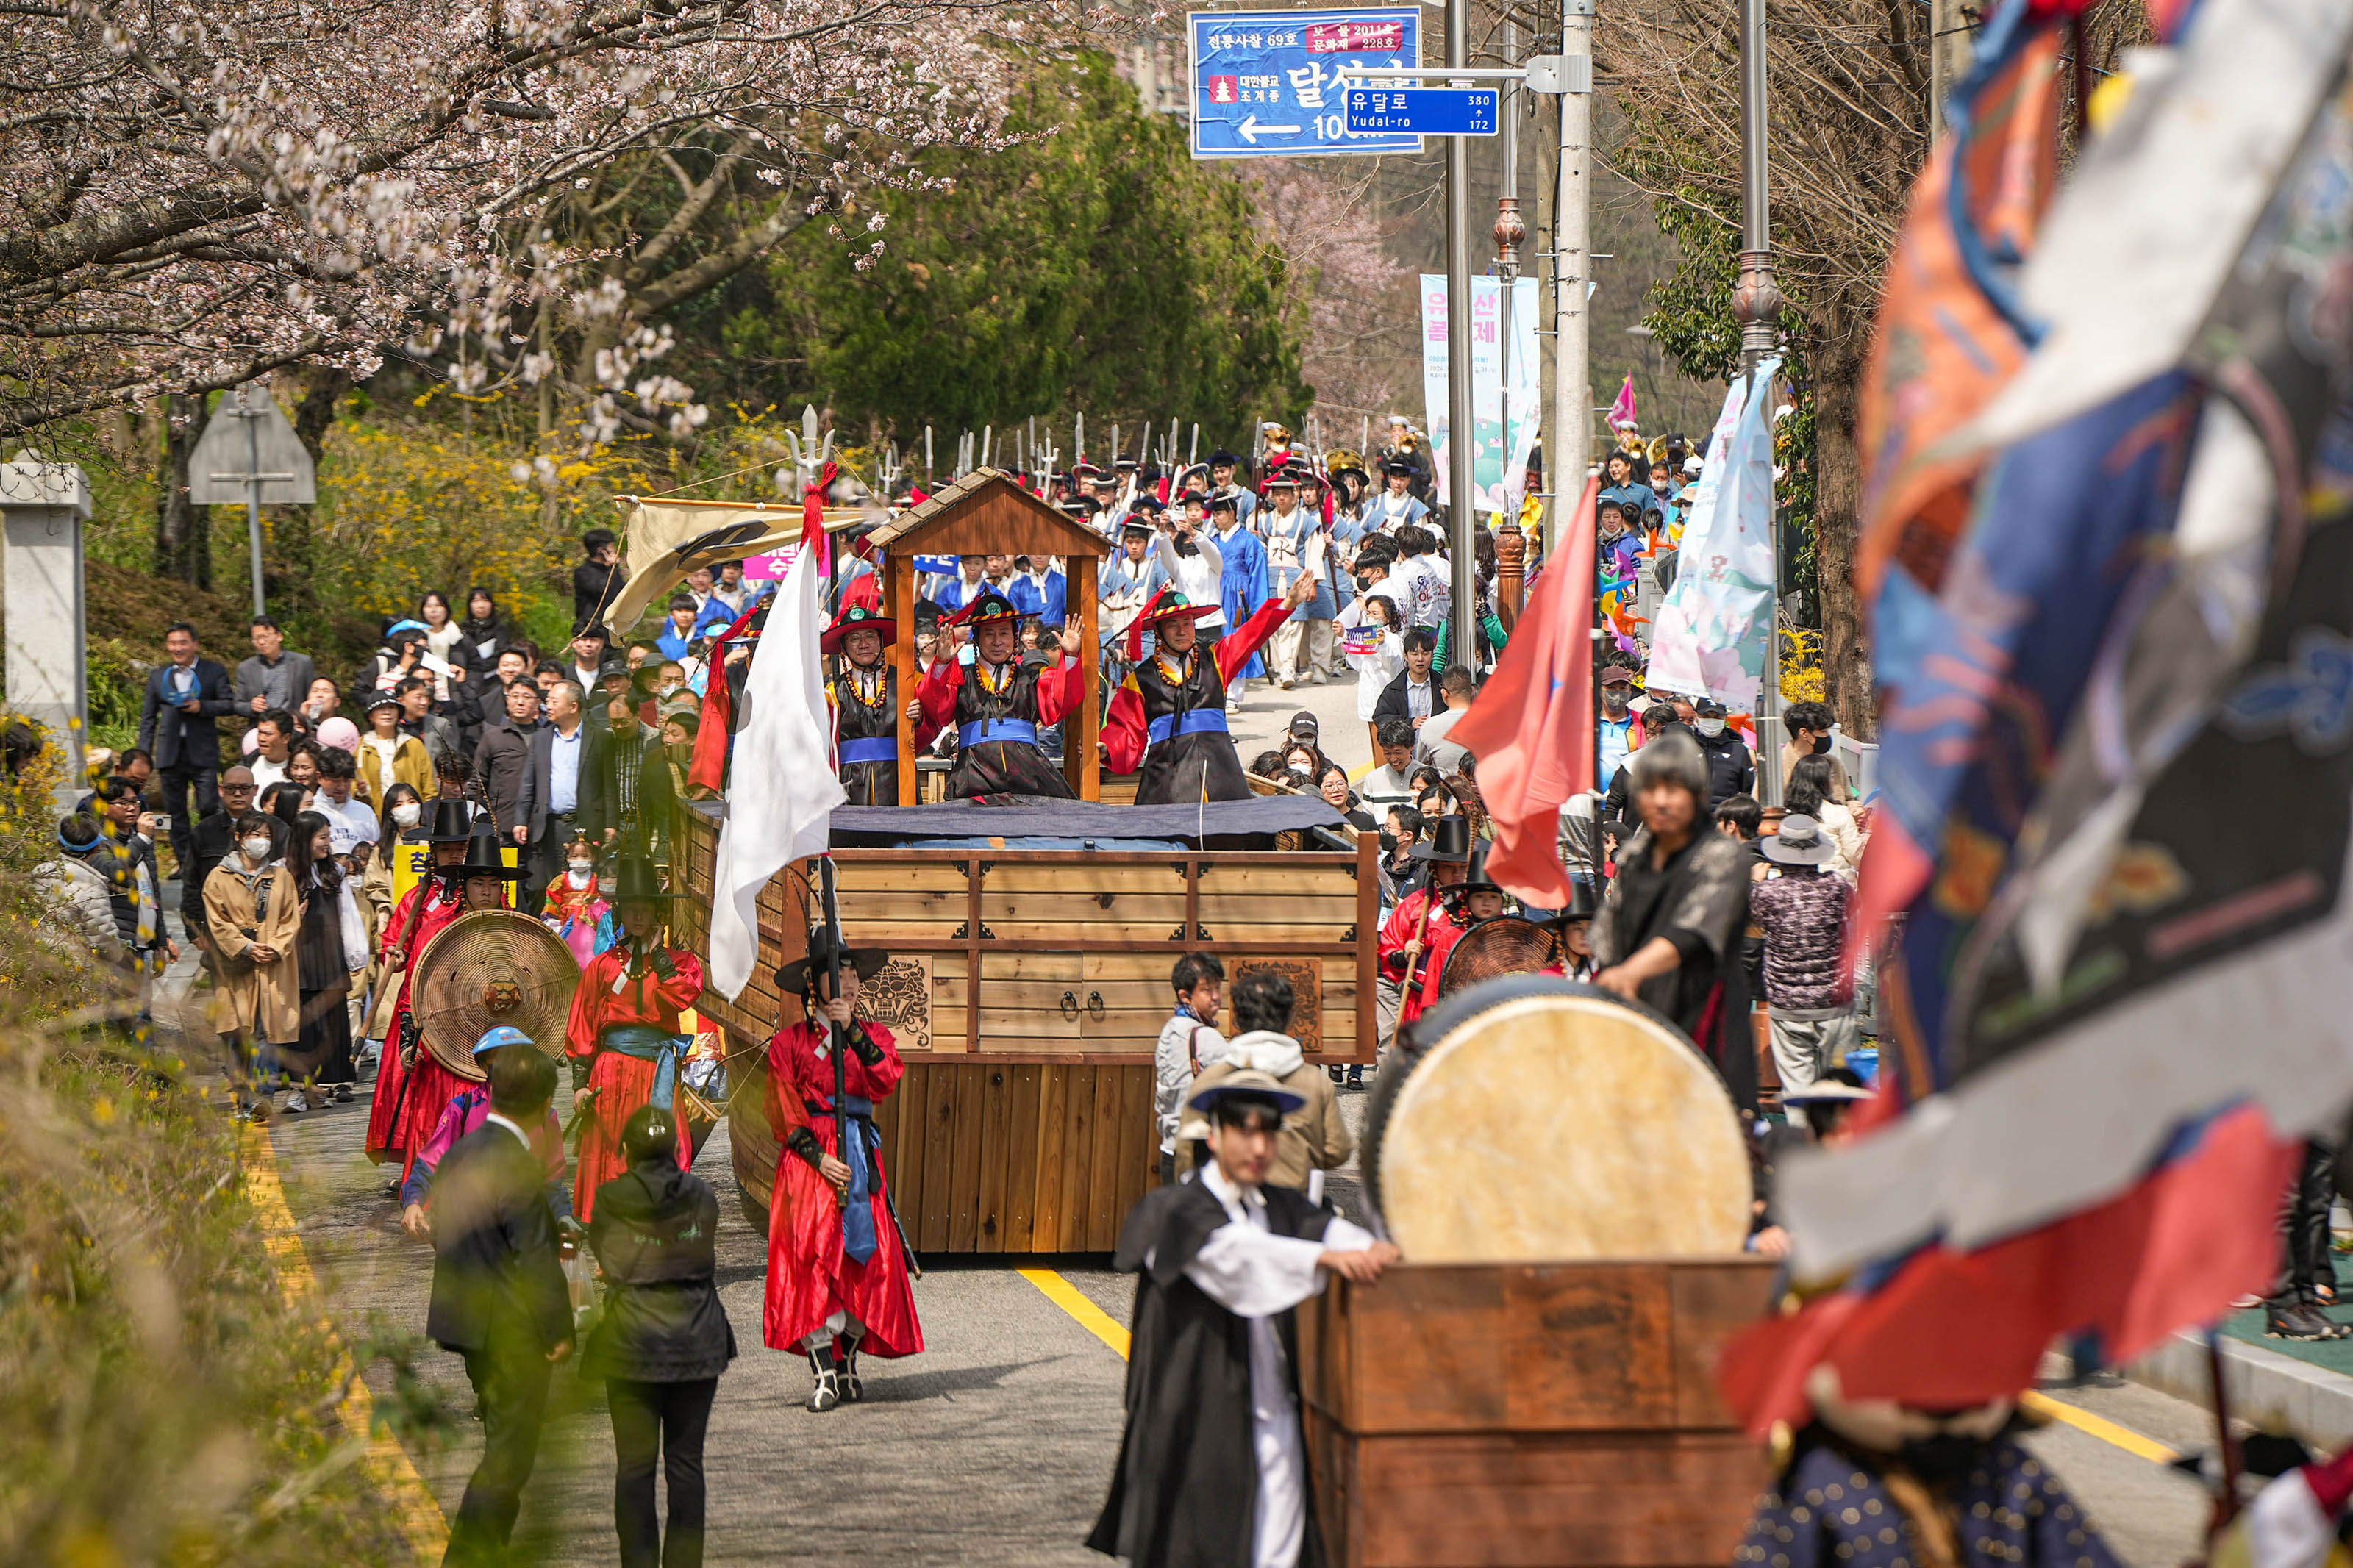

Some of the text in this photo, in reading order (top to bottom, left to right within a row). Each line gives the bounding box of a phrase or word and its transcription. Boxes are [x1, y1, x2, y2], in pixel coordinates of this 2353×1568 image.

[1354, 24, 1396, 37] 2011호
[1207, 33, 1299, 49] 전통사찰 69호
[1313, 37, 1396, 51] 문화재 228호
[1240, 75, 1280, 89] 대한불교
[1351, 93, 1408, 113] 유달로
[1468, 96, 1490, 106] 380
[1351, 115, 1411, 127] Yudal-ro
[1469, 120, 1488, 130] 172
[1272, 540, 1296, 561] 水
